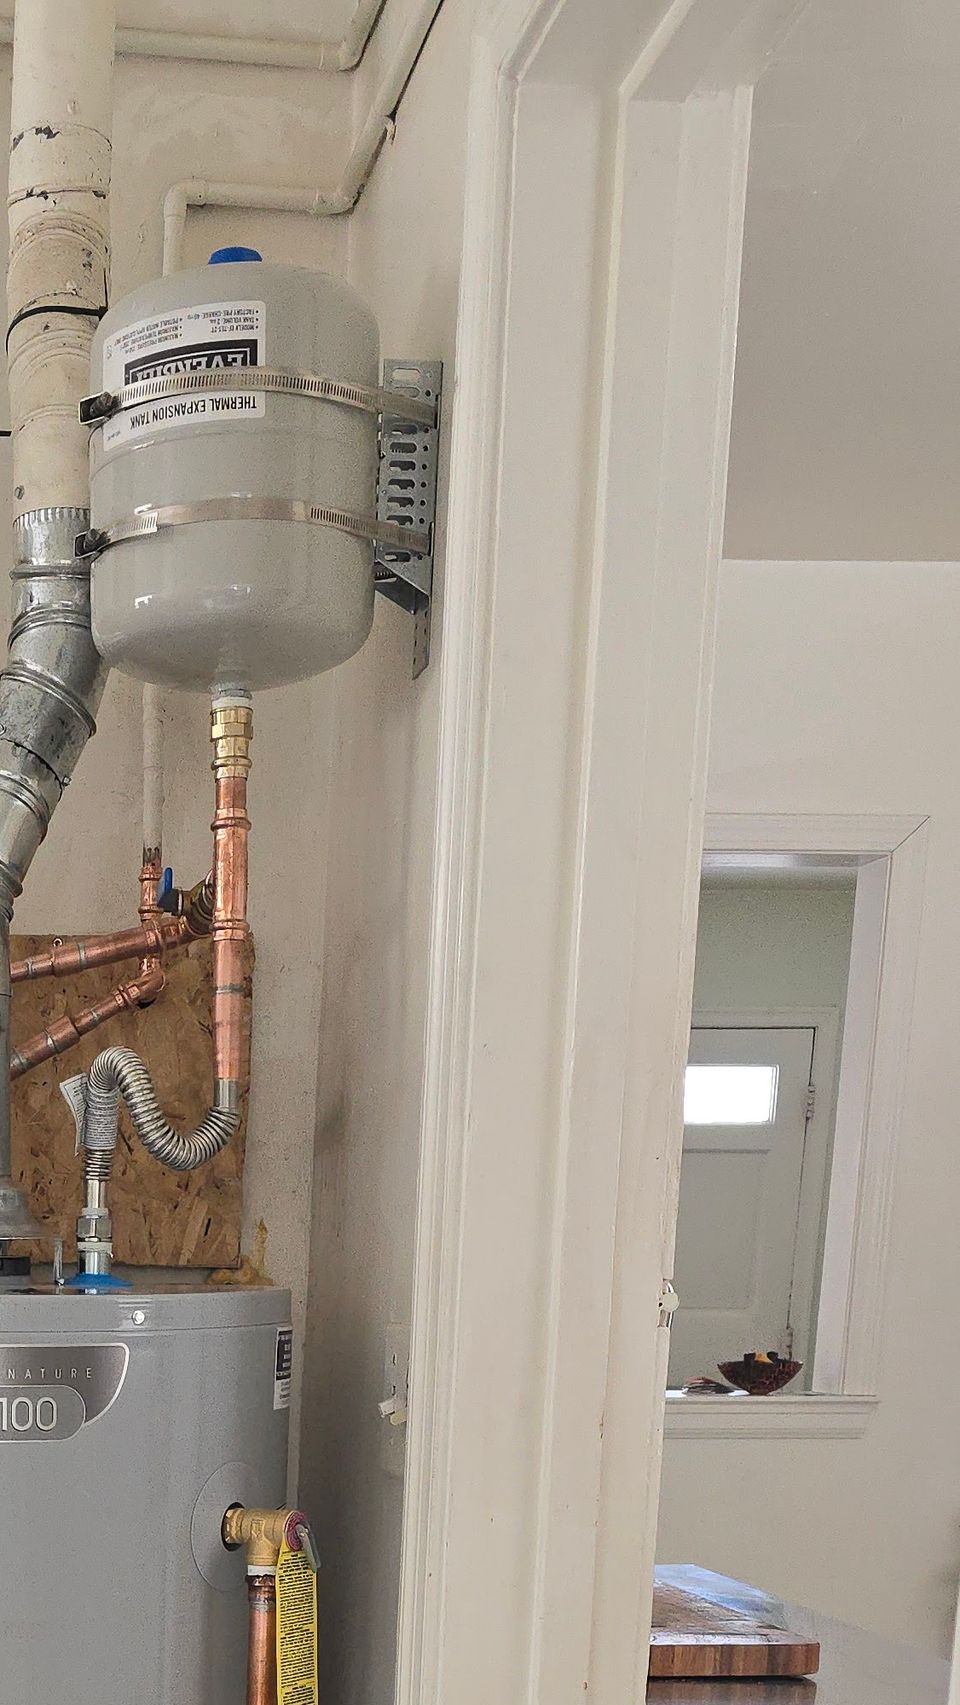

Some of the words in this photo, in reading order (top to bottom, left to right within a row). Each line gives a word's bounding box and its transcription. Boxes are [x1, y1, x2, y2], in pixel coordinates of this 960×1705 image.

[151, 400, 206, 419] EXPANSION
[209, 395, 257, 411] THERMAL
[129, 411, 151, 429] TANK
